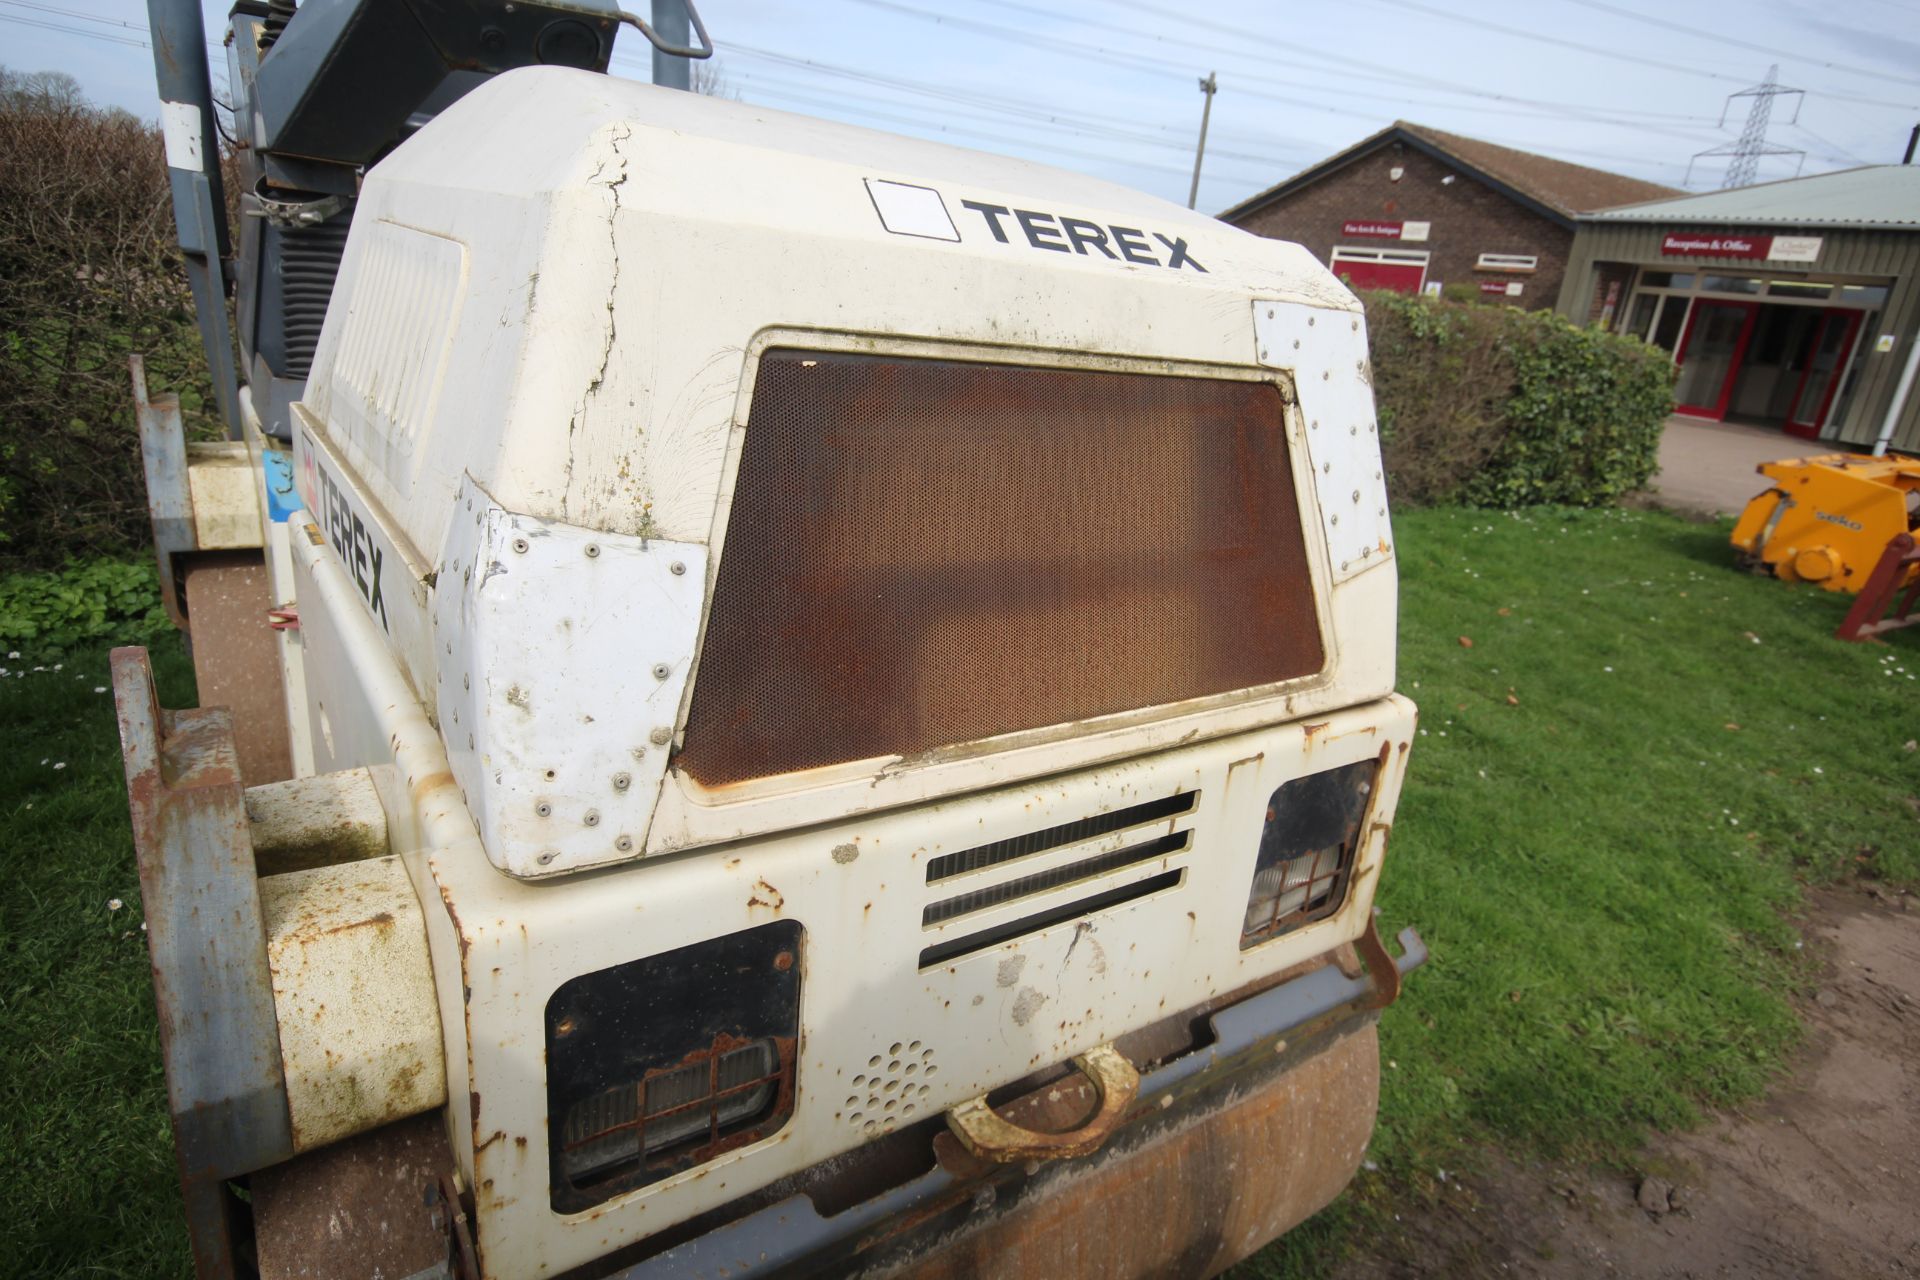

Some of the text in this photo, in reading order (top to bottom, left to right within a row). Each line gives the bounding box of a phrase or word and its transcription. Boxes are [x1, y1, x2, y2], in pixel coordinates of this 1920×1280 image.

[960, 199, 1210, 273] TEREX
[1664, 237, 1752, 252] Reception & Office
[318, 461, 390, 636] TEREX
